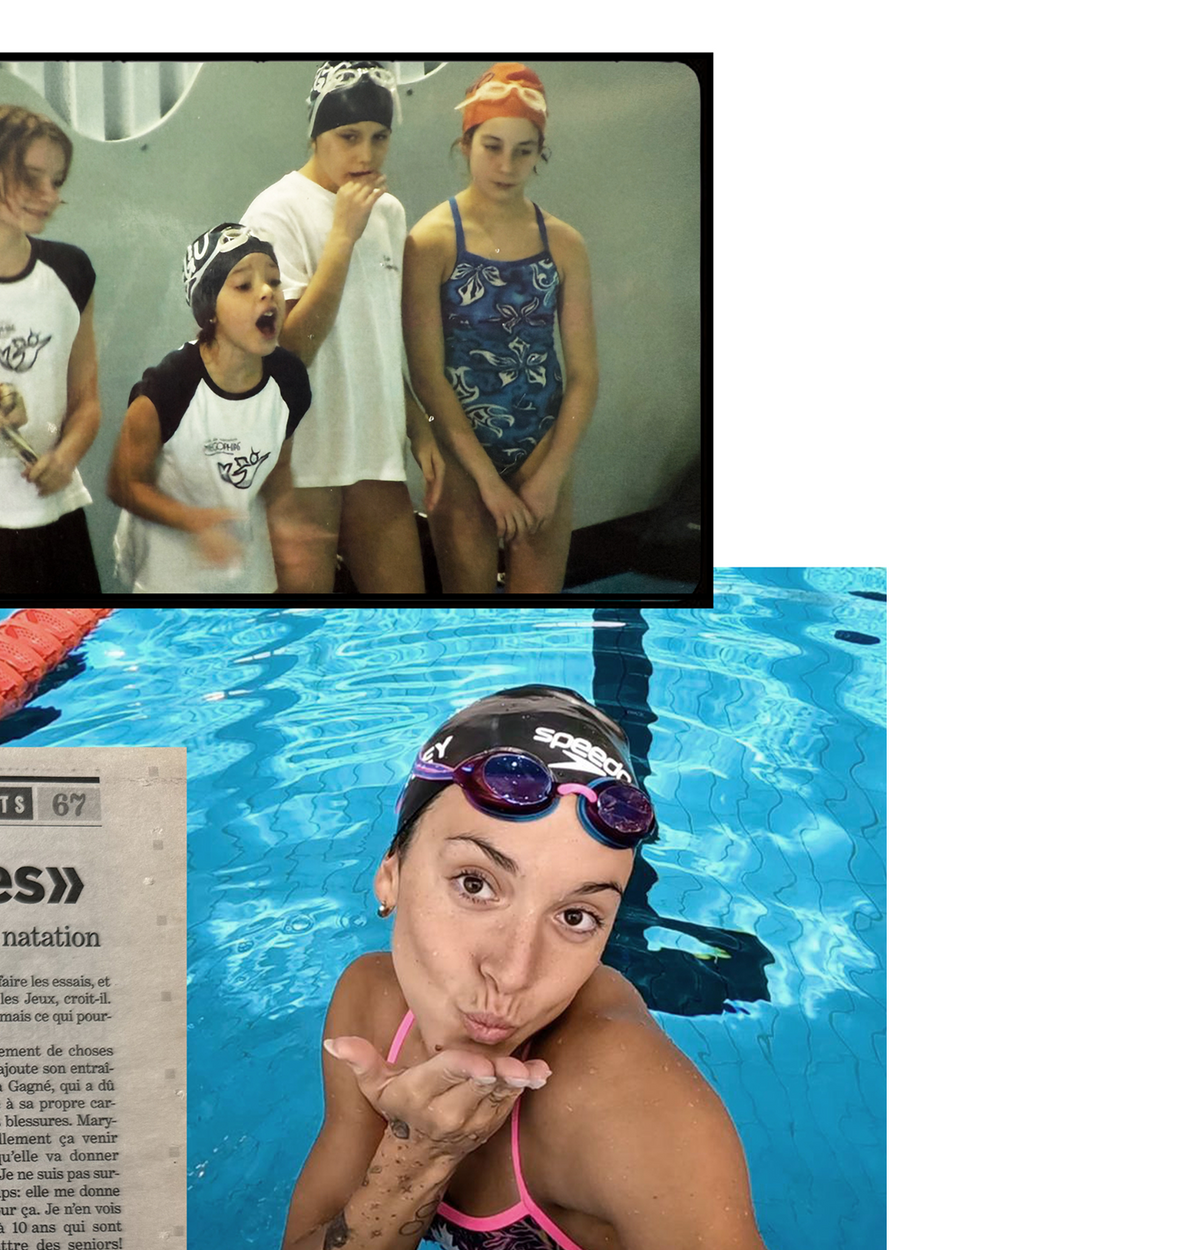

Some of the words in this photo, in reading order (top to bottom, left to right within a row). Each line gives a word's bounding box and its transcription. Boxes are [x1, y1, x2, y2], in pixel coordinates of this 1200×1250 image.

[51, 792, 87, 817] 67
[1, 924, 101, 948] natation
[30, 974, 50, 988] les
[51, 974, 95, 990] essais,
[96, 975, 111, 988] et
[0, 991, 20, 1005] les
[23, 991, 59, 1007] Jeux,
[63, 991, 111, 1005] croit-il.
[67, 1236, 123, 1250] seniors!
